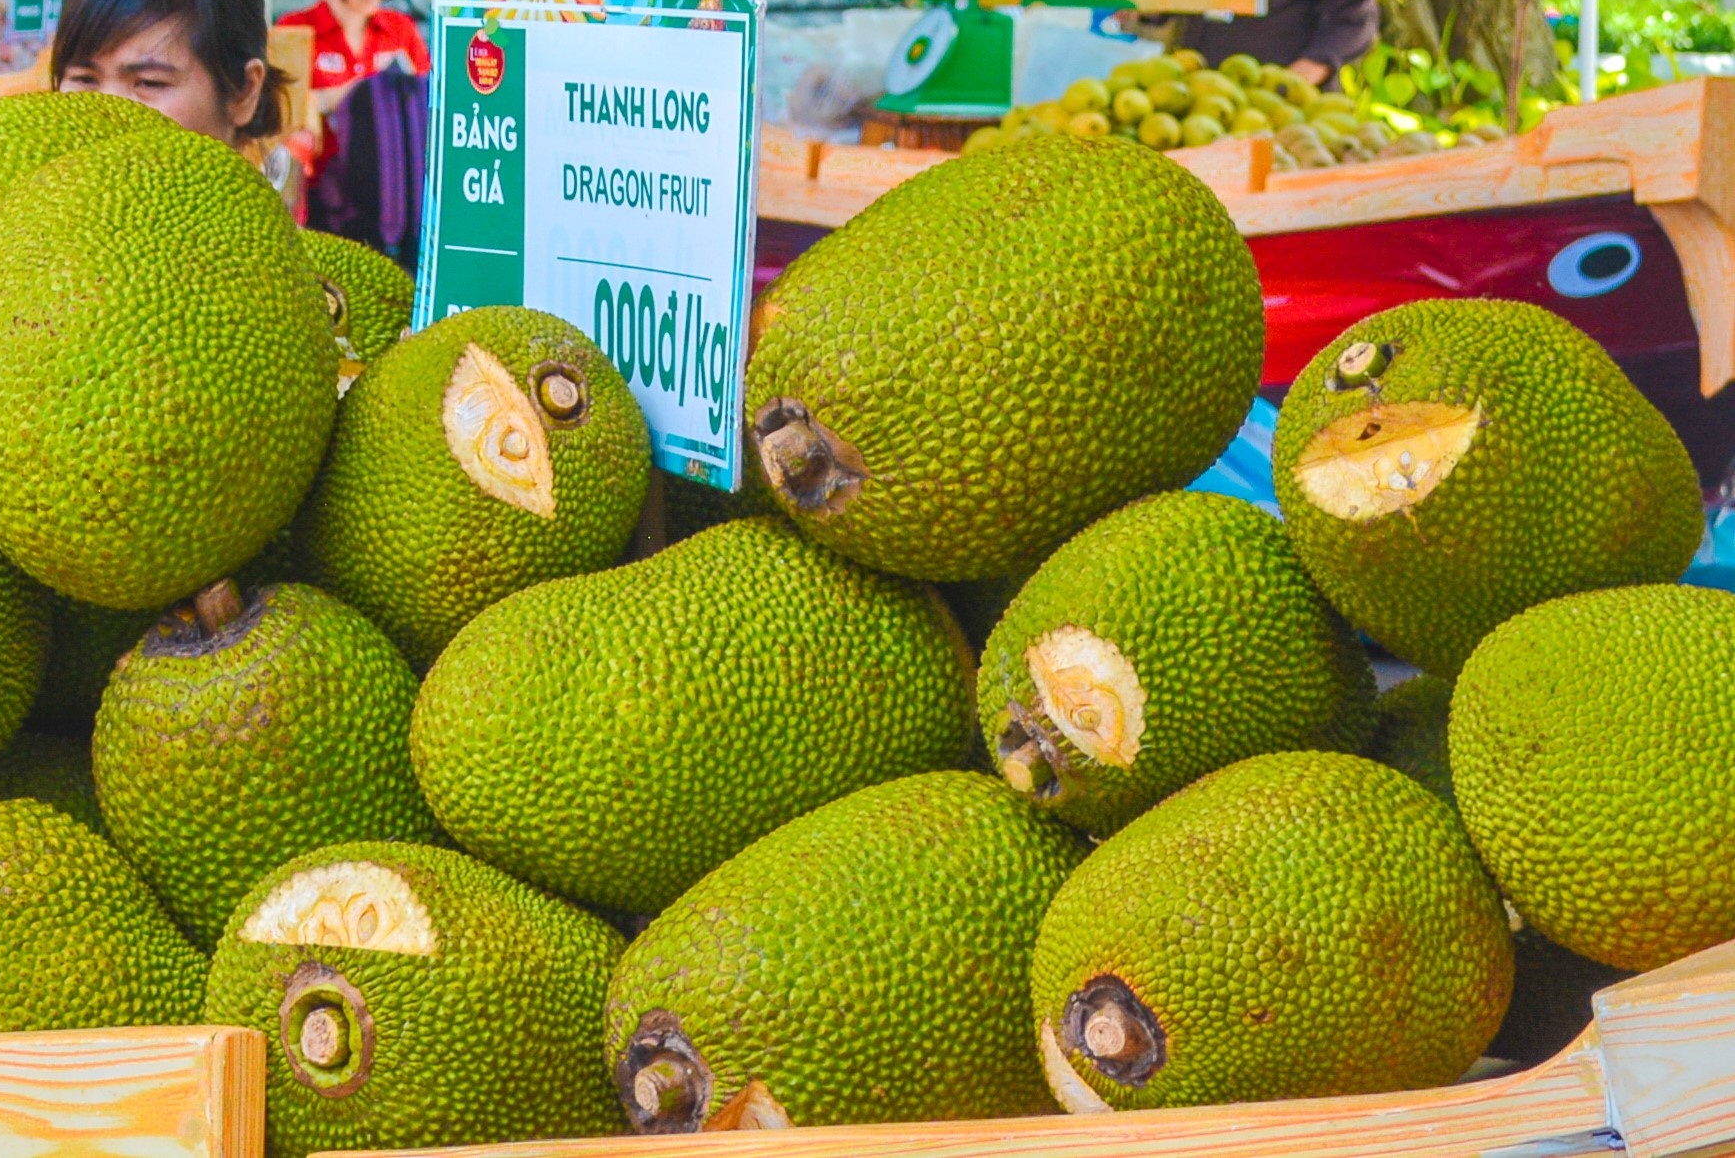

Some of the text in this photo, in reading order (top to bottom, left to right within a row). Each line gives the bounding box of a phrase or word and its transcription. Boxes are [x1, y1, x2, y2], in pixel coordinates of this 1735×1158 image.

[451, 103, 518, 152] BẢNG
[564, 82, 711, 135] THANH LONG
[462, 159, 505, 205] GIÁ
[562, 163, 712, 218] DRAGON FRUIT
